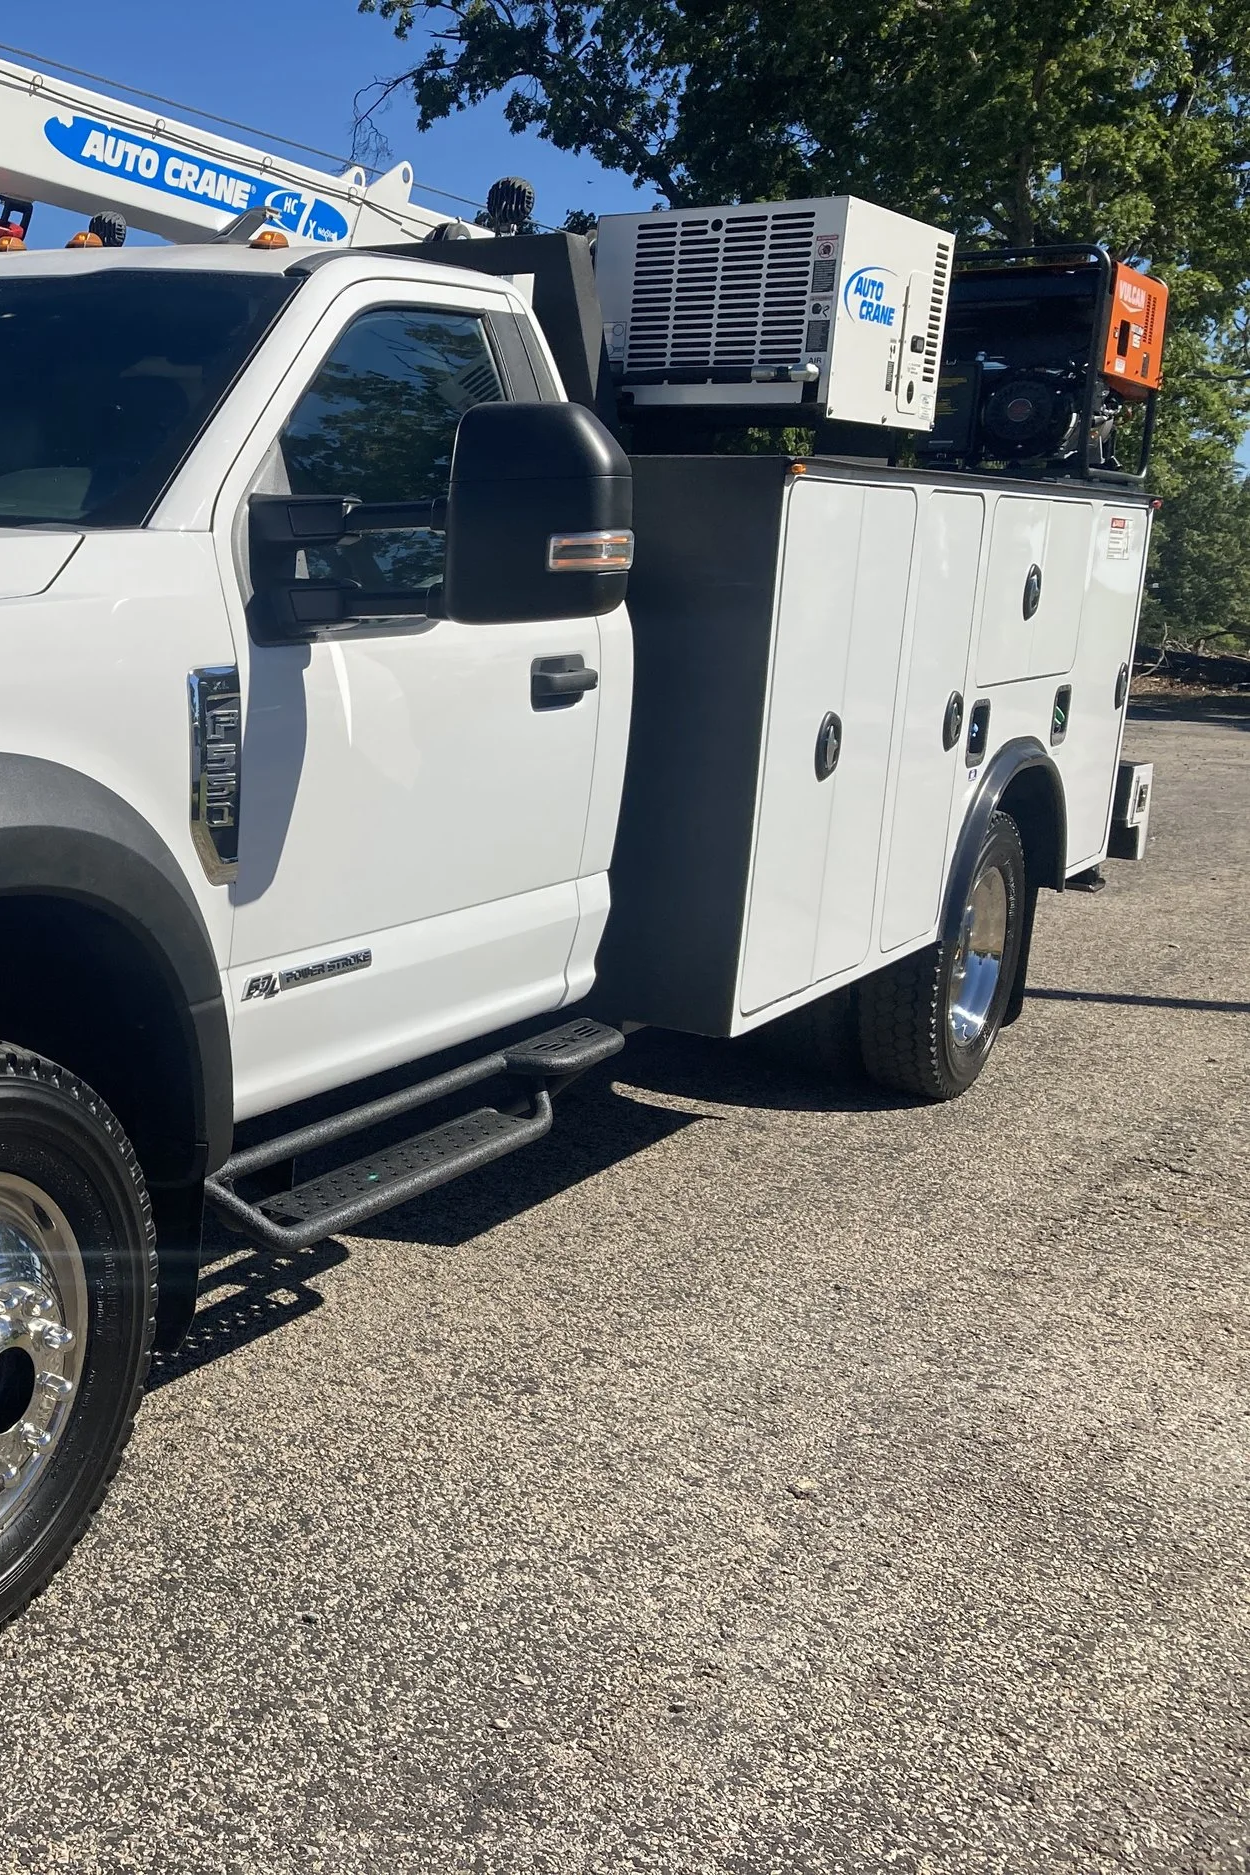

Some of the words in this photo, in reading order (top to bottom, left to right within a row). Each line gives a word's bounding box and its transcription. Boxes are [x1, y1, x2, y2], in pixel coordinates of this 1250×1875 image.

[81, 130, 159, 179] AUTO
[164, 156, 253, 209] CRANE
[283, 196, 299, 215] HC
[854, 276, 884, 301] AUTO
[859, 300, 895, 326] CRANE
[286, 964, 325, 982] POWER
[327, 952, 371, 972] STROKE
